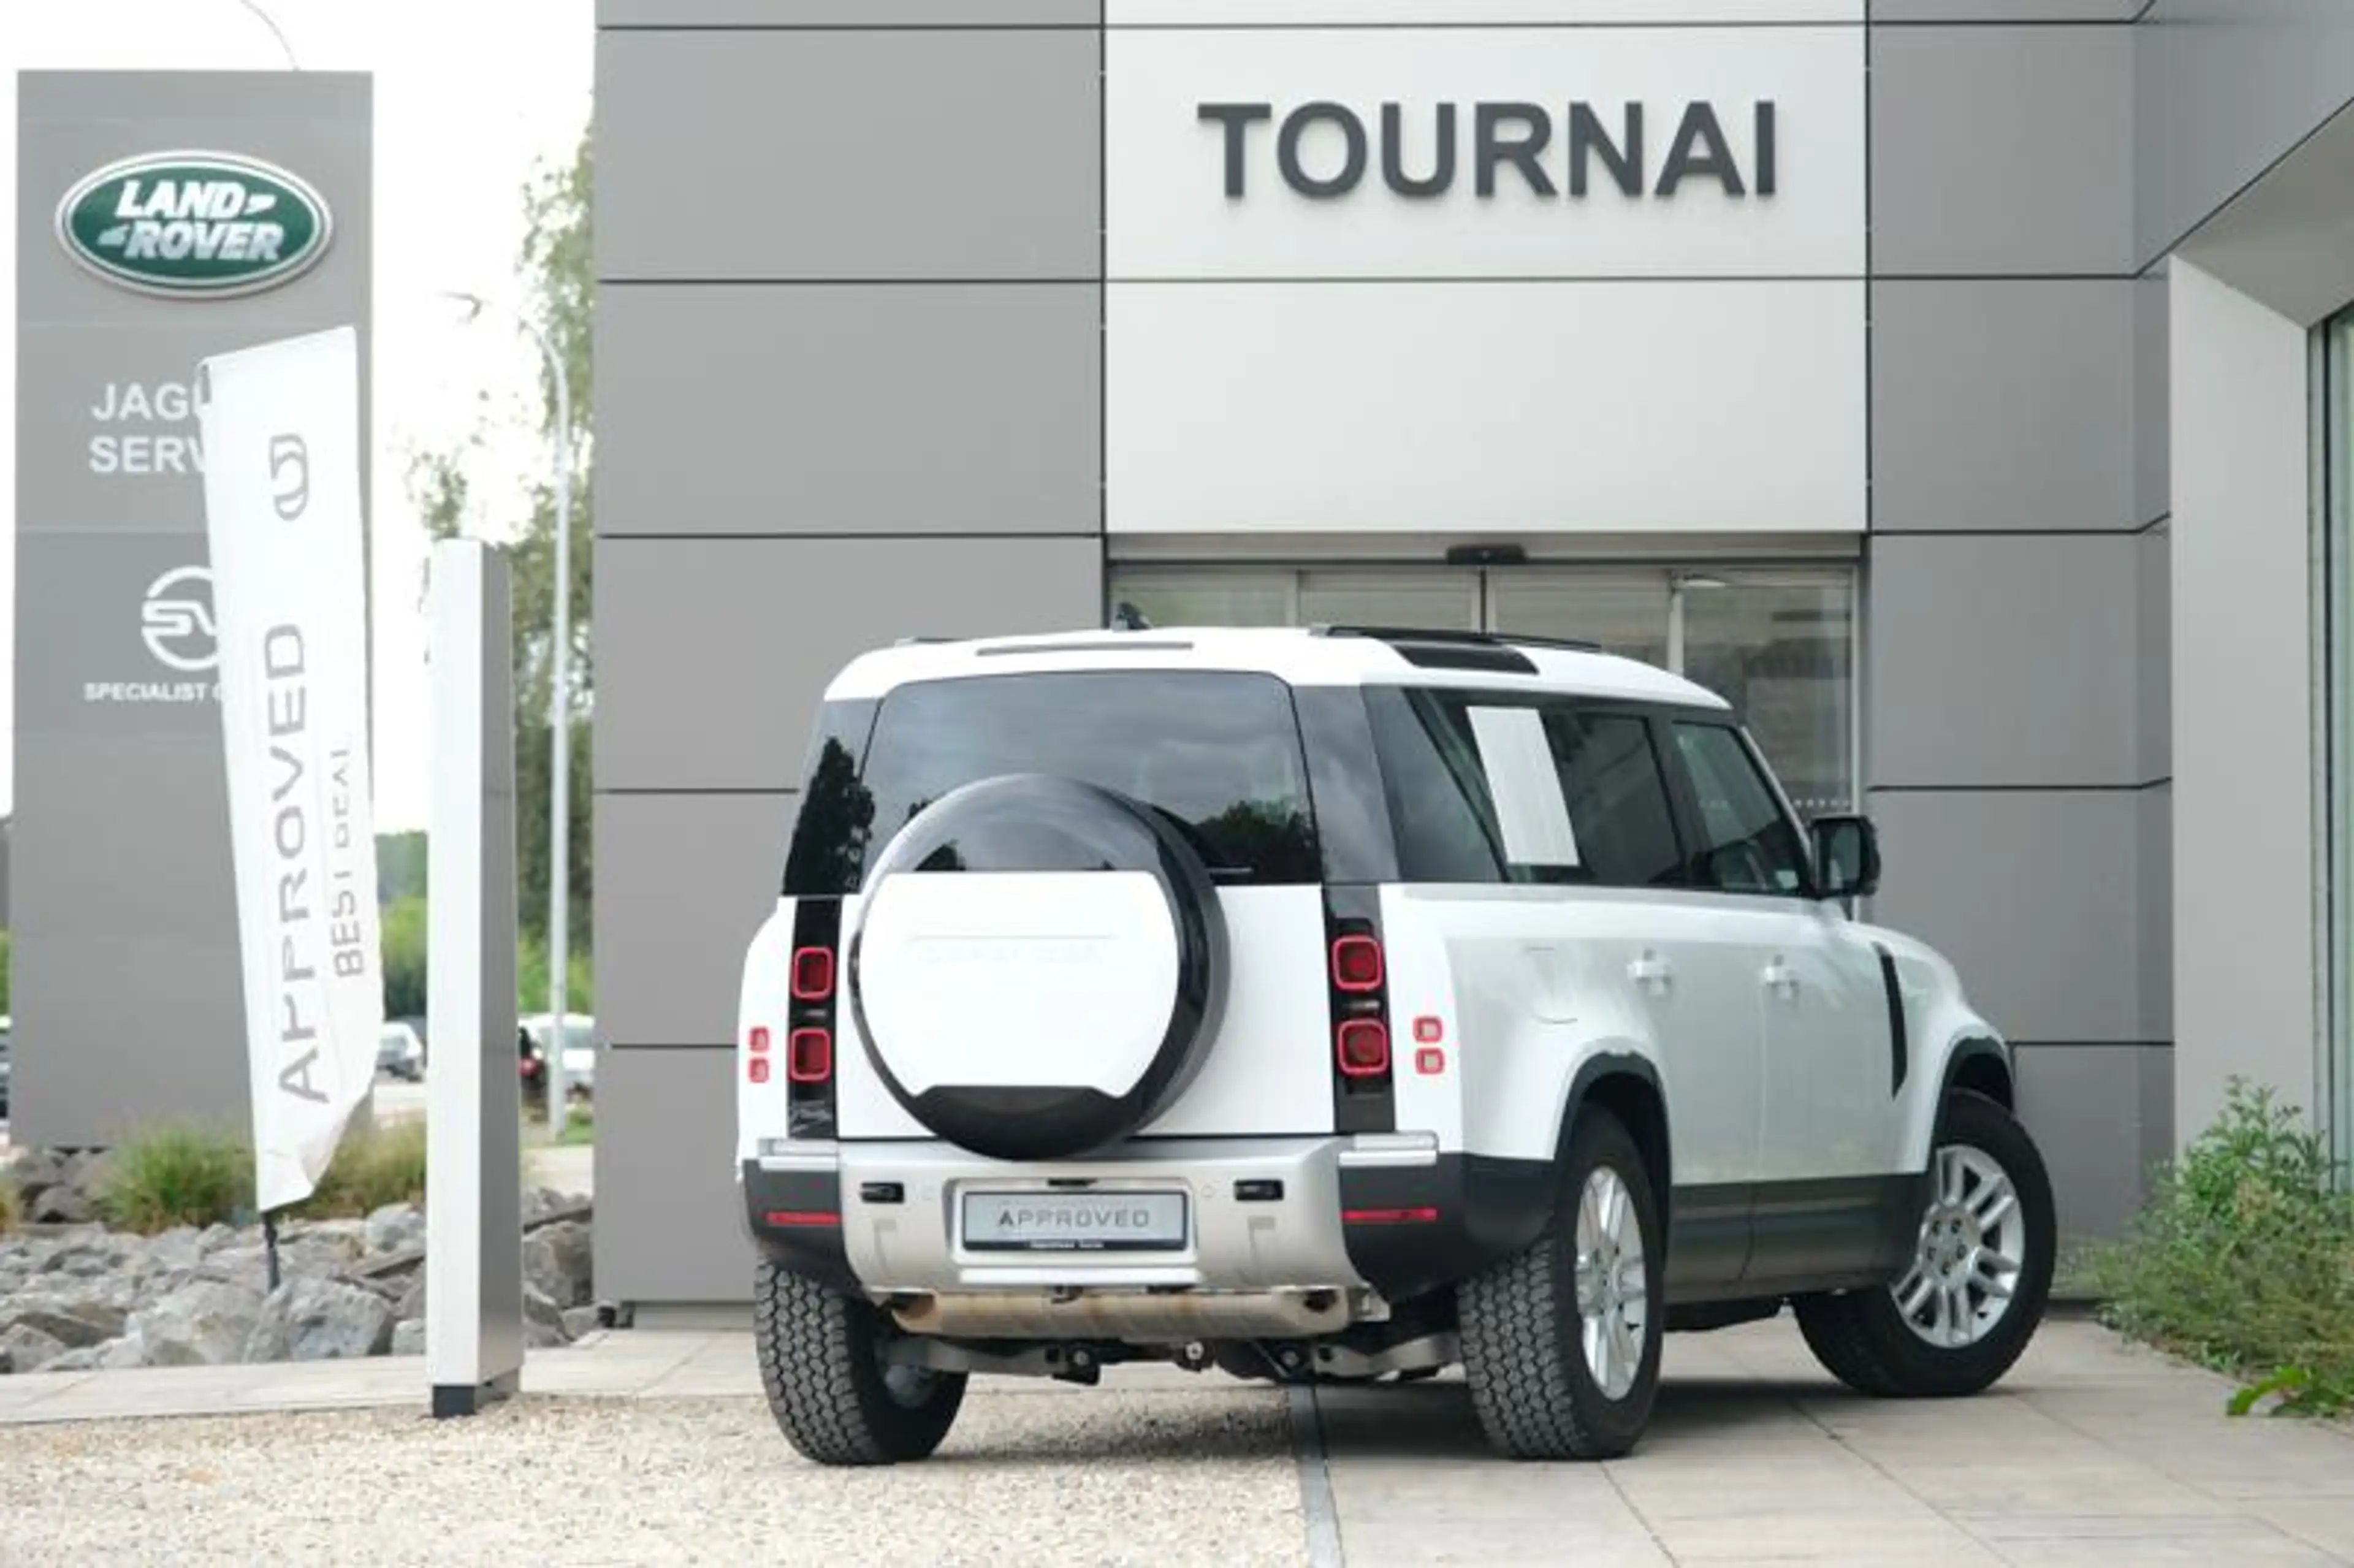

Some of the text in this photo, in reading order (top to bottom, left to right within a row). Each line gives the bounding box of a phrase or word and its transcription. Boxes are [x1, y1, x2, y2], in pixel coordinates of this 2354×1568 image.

[1197, 101, 1777, 197] TOURNAI
[116, 181, 245, 218] LAND
[123, 224, 284, 261] ROVER
[264, 623, 329, 1105] APPROVED
[998, 1208, 1151, 1228] APPROVED
